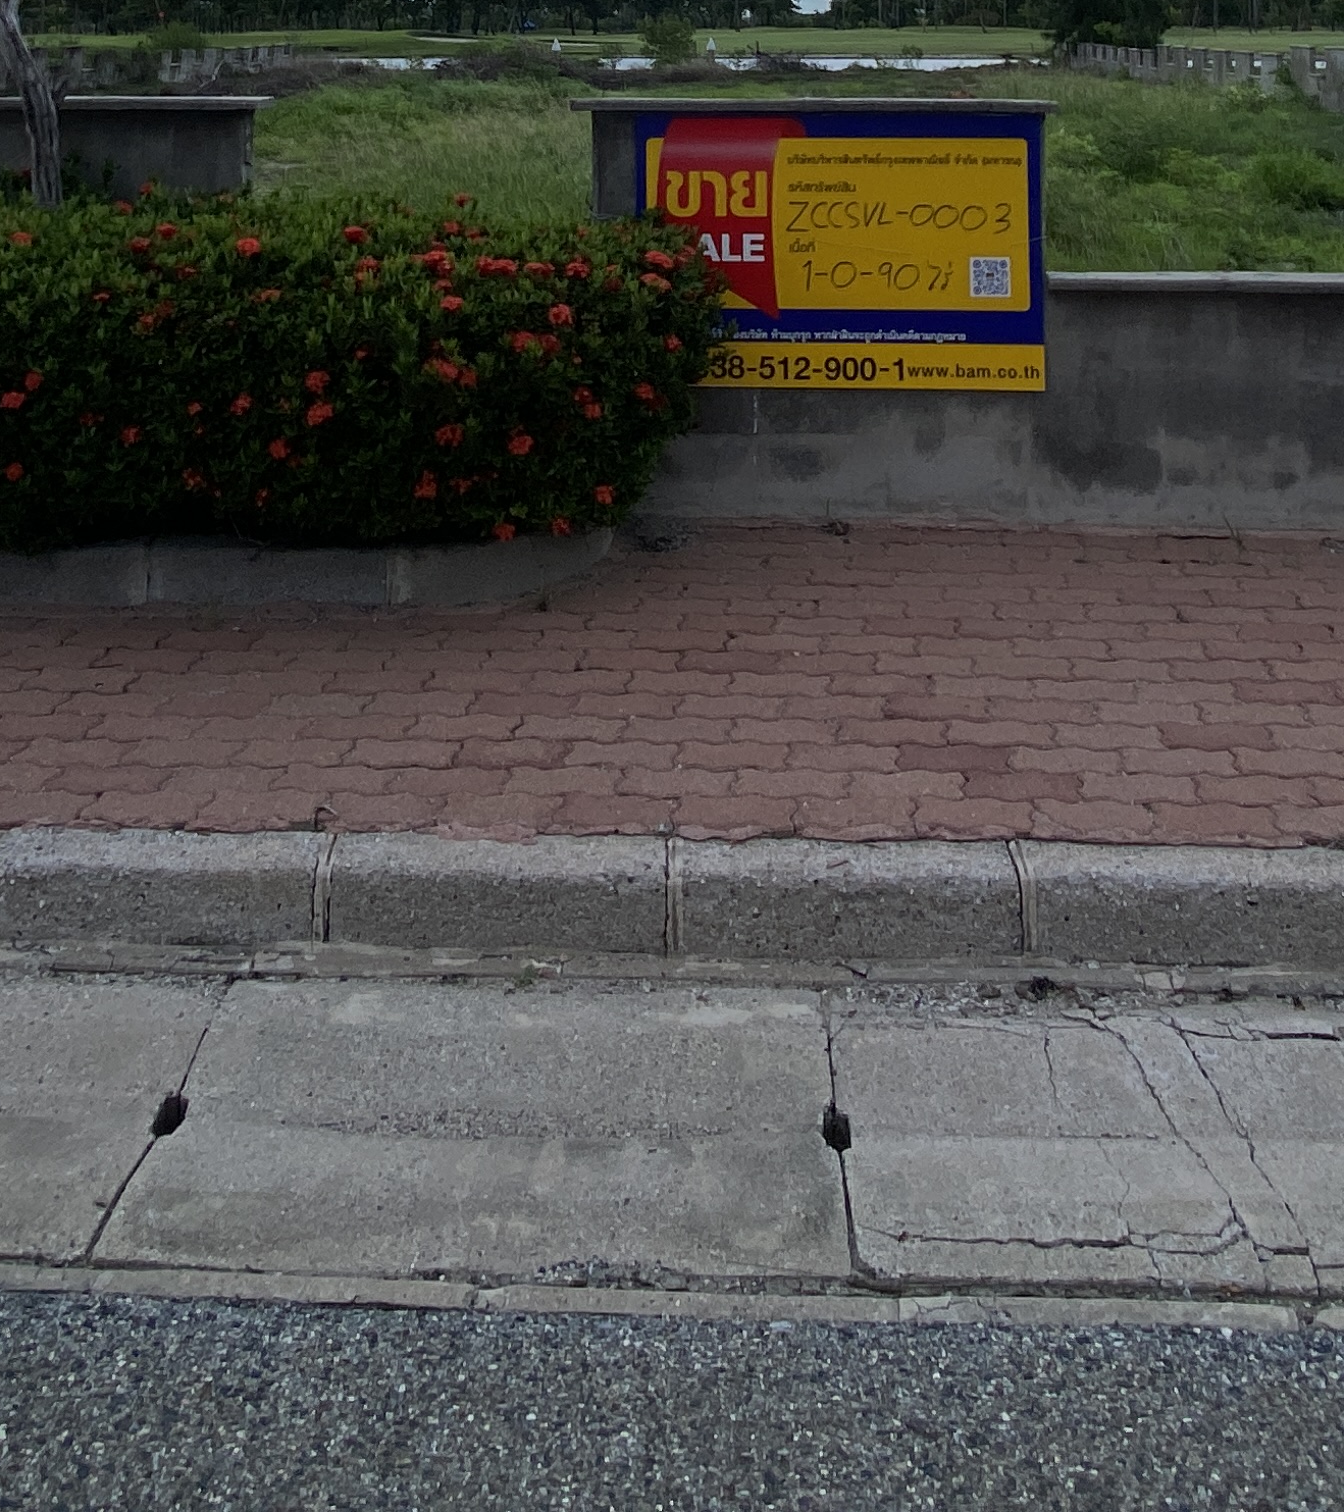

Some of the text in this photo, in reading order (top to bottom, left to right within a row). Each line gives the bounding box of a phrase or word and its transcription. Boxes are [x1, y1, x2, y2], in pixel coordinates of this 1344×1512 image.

[666, 170, 768, 217] ขาย
[697, 233, 765, 262] ALE
[704, 355, 1041, 381] 38-512-900-1 www.bam.co.th
